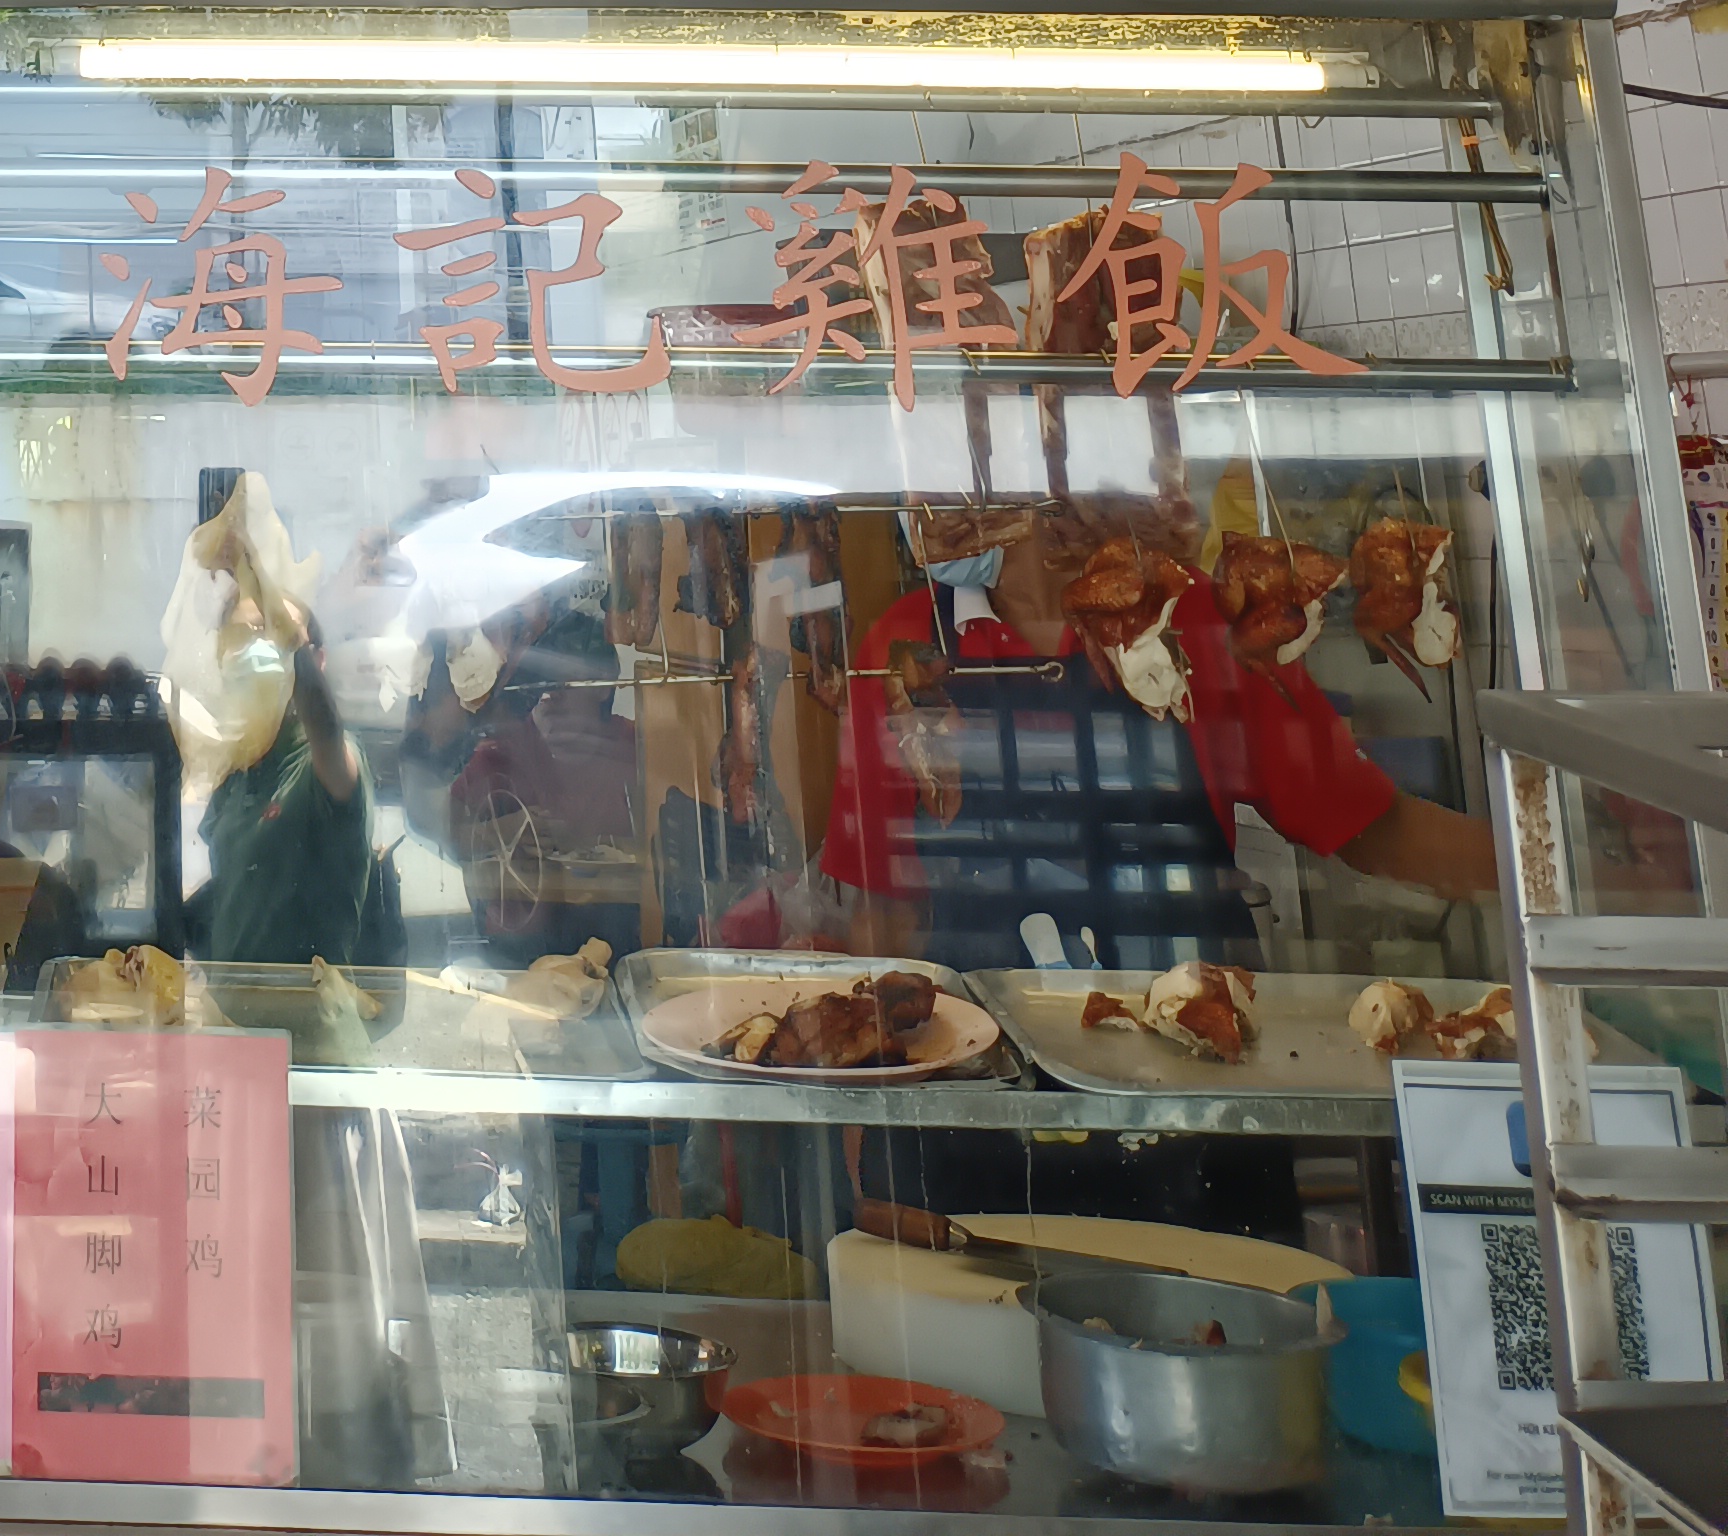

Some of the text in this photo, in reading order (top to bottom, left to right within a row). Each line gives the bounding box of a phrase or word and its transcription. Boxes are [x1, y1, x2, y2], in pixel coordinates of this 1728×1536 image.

[100, 150, 1370, 414] 海記雞飯
[83, 1082, 123, 1350] 大山脚鸡
[183, 1085, 224, 1280] 菜园鸡
[1430, 1193, 1461, 1206] SCAN
[1463, 1195, 1495, 1207] WITH
